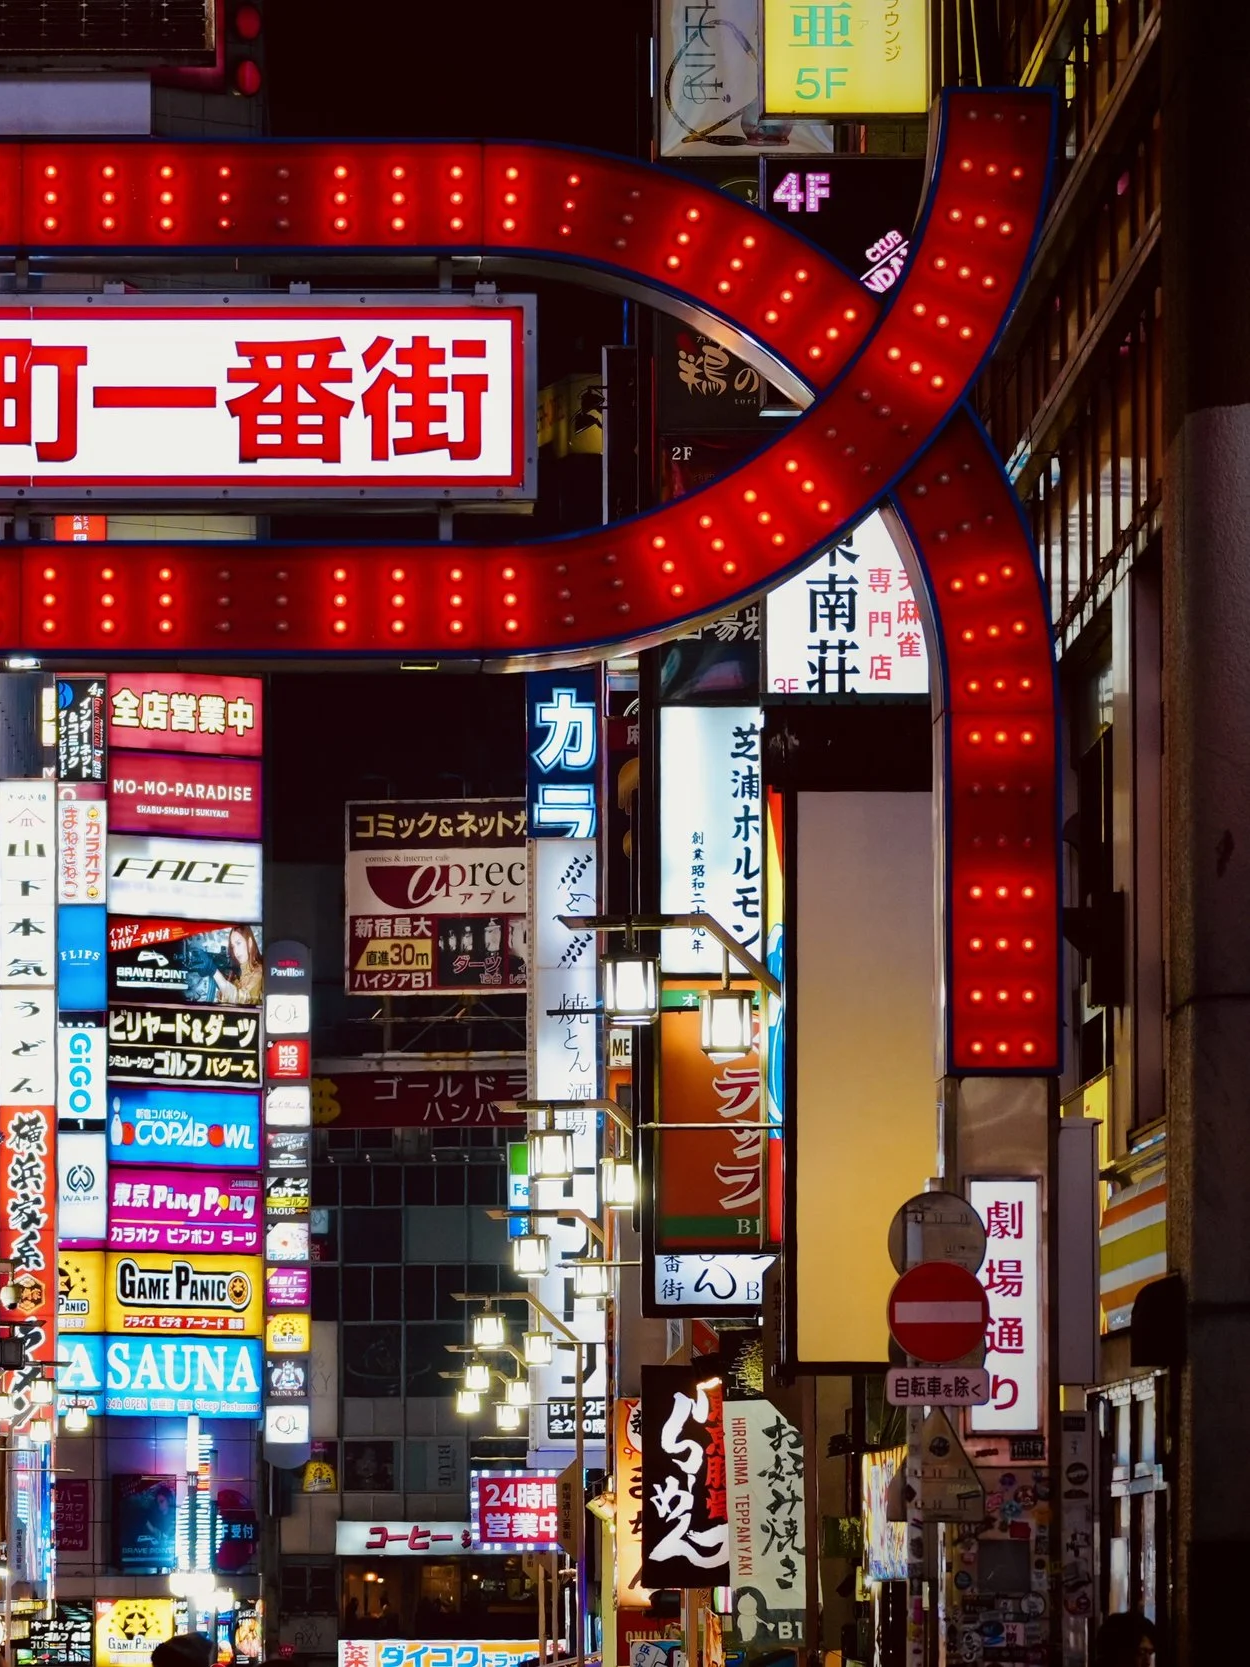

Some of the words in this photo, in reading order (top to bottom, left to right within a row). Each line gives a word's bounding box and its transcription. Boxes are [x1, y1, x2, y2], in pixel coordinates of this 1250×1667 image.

[788, 2, 854, 47] 亜
[795, 68, 848, 99] 5F
[772, 172, 831, 212] 4F
[865, 230, 902, 263] CLUB
[672, 447, 693, 461] 2F
[867, 568, 892, 680] 専門店
[111, 687, 254, 735] 全店営業中
[112, 779, 253, 802] MO-MO-PARADISE
[136, 804, 190, 816] SHABU-SHABU
[196, 807, 229, 818] SUKIYAKI
[730, 723, 761, 948] 芝浦ホルモン
[63, 805, 79, 899] まねきねこ
[85, 821, 100, 885] カラオケ
[112, 857, 255, 885] FACE
[109, 924, 139, 939] インドア
[355, 917, 432, 938] 新宿最大
[61, 950, 101, 962] FLIPS
[366, 943, 430, 967] 直進30m
[116, 967, 153, 978] BRAVE
[155, 968, 189, 979] POINT
[354, 972, 433, 989] ハイジアB1
[109, 1010, 257, 1048] ビリヤード&ダーツ
[557, 992, 591, 1073] 焼とん
[278, 1045, 298, 1055] MO
[69, 1033, 91, 1114] GiGO
[205, 1057, 258, 1079] バグース
[6, 1111, 47, 1270] 横浜家系
[112, 1182, 151, 1207] 東京
[152, 1184, 201, 1218] Ping
[204, 1186, 256, 1220] Pong
[110, 1227, 160, 1243] カラオケ
[221, 1230, 257, 1246] ダーツ
[119, 1262, 170, 1300] GAME
[175, 1265, 227, 1302] PANIC
[983, 1200, 1024, 1411] 劇場通り
[124, 1316, 155, 1328] プライズ
[158, 1317, 183, 1328] ビデオ
[186, 1318, 225, 1330] アーケード
[106, 1342, 260, 1393] SAUNA
[895, 1376, 982, 1399] 自転車を除く
[125, 1399, 148, 1410] OPEN
[195, 1399, 219, 1413] Sleep
[731, 1417, 748, 1487] HIROSHIMA
[760, 1416, 805, 1590] お好み焼き
[365, 1526, 453, 1550] コーヒー
[485, 1513, 558, 1538] 営業中
[380, 1645, 480, 1667] ダイコク
